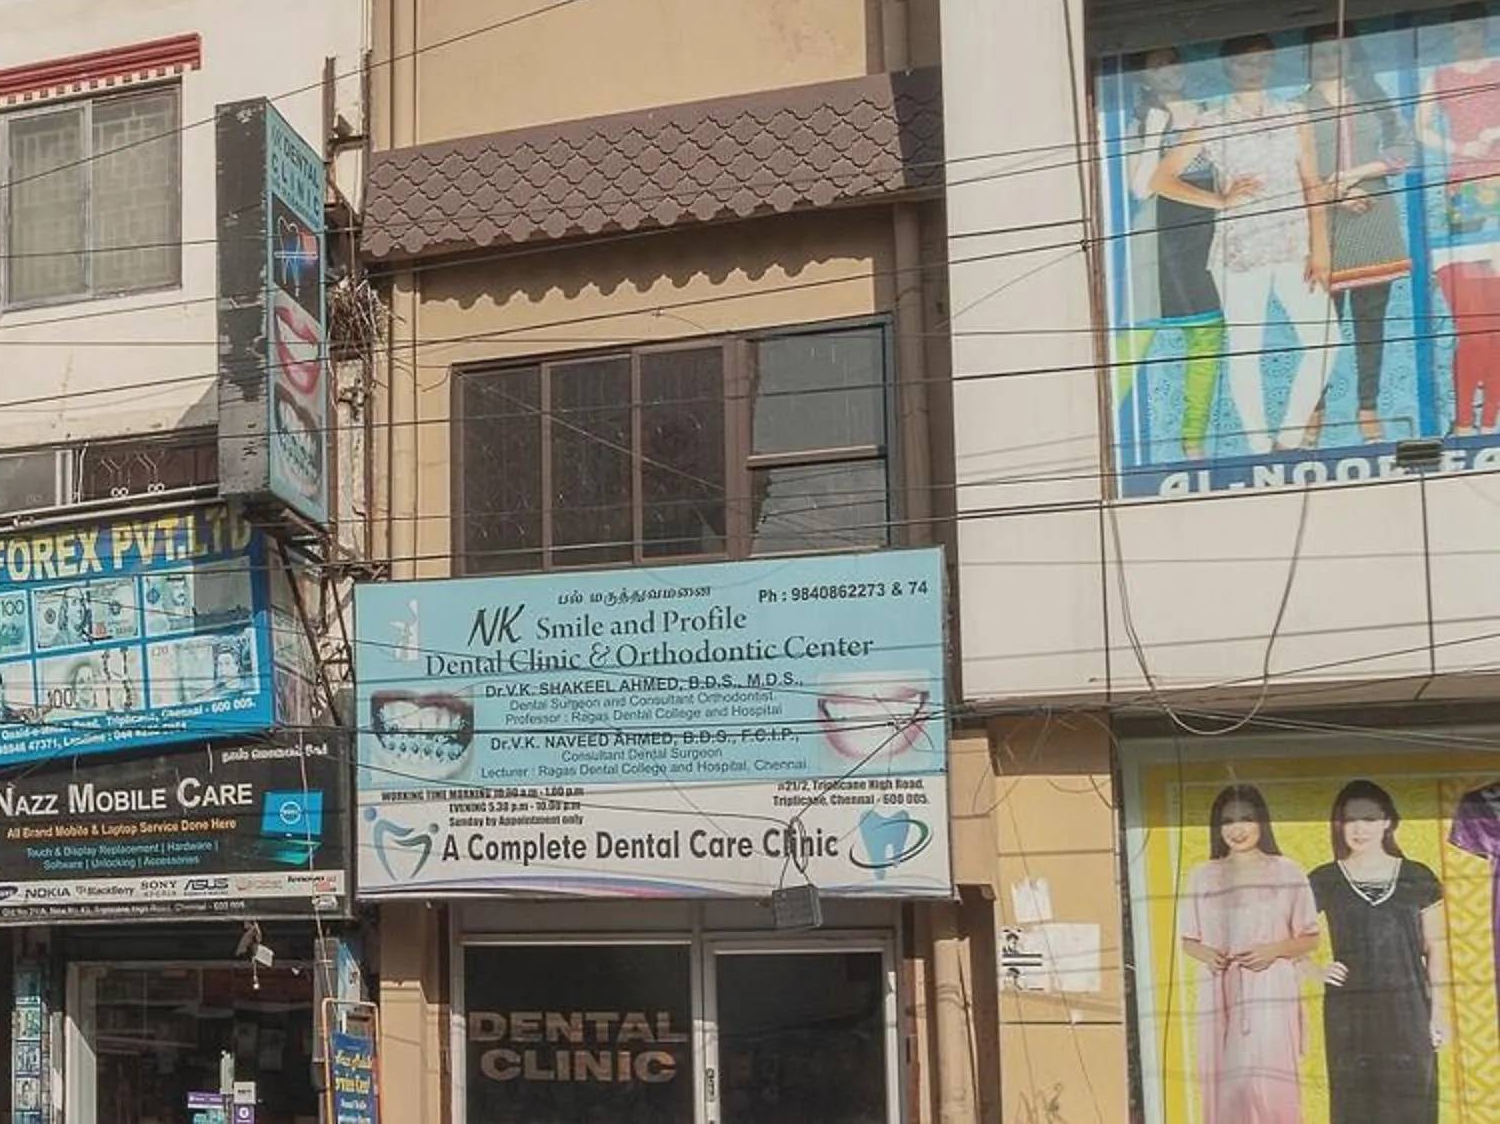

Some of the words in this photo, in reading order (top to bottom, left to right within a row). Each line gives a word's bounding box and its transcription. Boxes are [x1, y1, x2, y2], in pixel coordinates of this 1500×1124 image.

[758, 588, 777, 604] Ph
[791, 582, 886, 602] 9840862273
[891, 581, 903, 597] &
[908, 579, 929, 595] 74
[467, 603, 526, 647] NK
[536, 612, 605, 640] Smile
[610, 609, 656, 636] and
[663, 605, 748, 634] Profile
[426, 649, 502, 677] Dental
[509, 647, 582, 674] Clinic
[589, 641, 611, 669] &
[615, 638, 778, 668] Orthodontic
[784, 634, 874, 660] Center
[539, 679, 615, 696] SHAKEEL
[619, 676, 684, 694] AHMED,
[510, 699, 547, 712] Dental
[551, 696, 600, 712] Surgeon
[603, 694, 626, 708] and
[629, 692, 694, 708] Consultant
[506, 712, 562, 726] Professor
[613, 708, 652, 722] Dental
[655, 706, 701, 722] College
[705, 705, 728, 718] and
[545, 732, 609, 750] NAVEED
[561, 749, 626, 763] Consultant
[628, 747, 667, 761] Dental
[670, 746, 723, 761] Surgeon
[579, 763, 619, 777] Dental
[621, 762, 666, 777] College
[670, 761, 693, 774] and
[68, 782, 167, 814] MOBILE
[176, 777, 253, 809] CARE
[869, 779, 893, 793] High
[883, 793, 903, 806] 600
[139, 819, 179, 833] Service
[181, 818, 209, 831] Done
[211, 817, 238, 830] Here
[449, 815, 484, 828] Sunday
[486, 815, 498, 828] by
[499, 814, 561, 828] Appointment
[562, 813, 584, 827] only
[442, 833, 460, 862] A
[467, 831, 588, 867] Complete
[595, 829, 680, 860] Dental
[689, 829, 753, 859] Care
[762, 827, 840, 859] Clinic
[25, 886, 71, 899] NOKIA
[140, 879, 177, 890] SONY
[183, 877, 230, 891] ASUS
[467, 1010, 688, 1043] DENTAL
[479, 1048, 678, 1084] CLINIC
